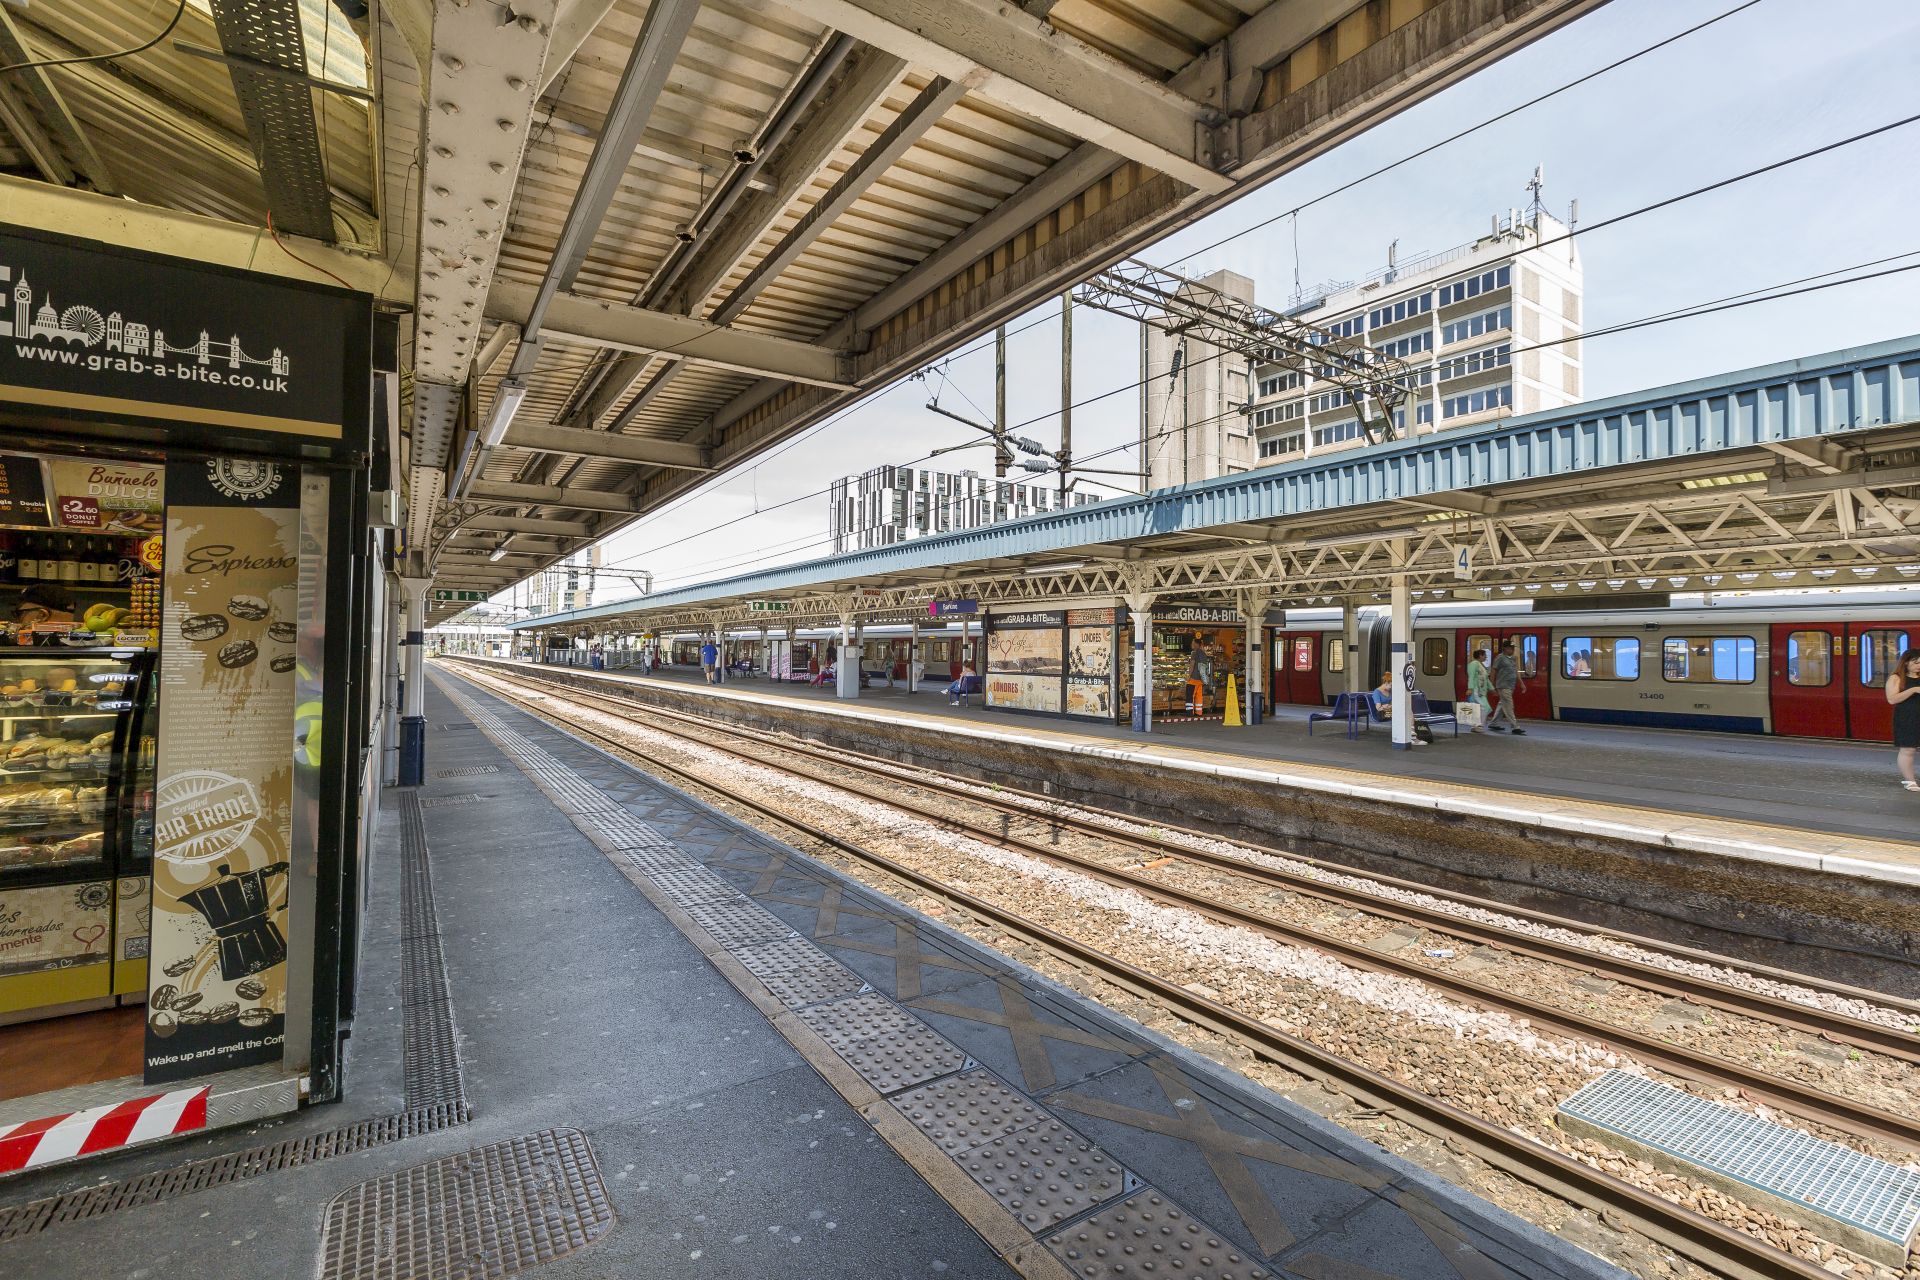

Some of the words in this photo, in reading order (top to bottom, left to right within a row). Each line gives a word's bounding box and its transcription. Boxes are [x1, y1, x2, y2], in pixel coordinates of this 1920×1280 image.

[15, 344, 288, 393] www.grab-a-bite.co.uk
[88, 466, 158, 487] Buñuelo
[88, 483, 159, 499] DULCE
[63, 500, 98, 513] £2.60
[65, 513, 97, 521] DONUT
[185, 544, 297, 577] Espresso
[1459, 548, 1469, 571] 4
[1008, 614, 1047, 624] GRAB-A-BITE
[1081, 633, 1102, 643] LONDRES
[993, 681, 1019, 693] LONDRES
[155, 816, 190, 844] AIR
[190, 794, 253, 831] TRADE
[148, 1056, 178, 1067] Wake
[180, 1053, 194, 1062] up
[195, 1046, 216, 1058] and
[217, 1042, 244, 1055] smell
[245, 1040, 262, 1049] the
[263, 1034, 284, 1046] Coff
